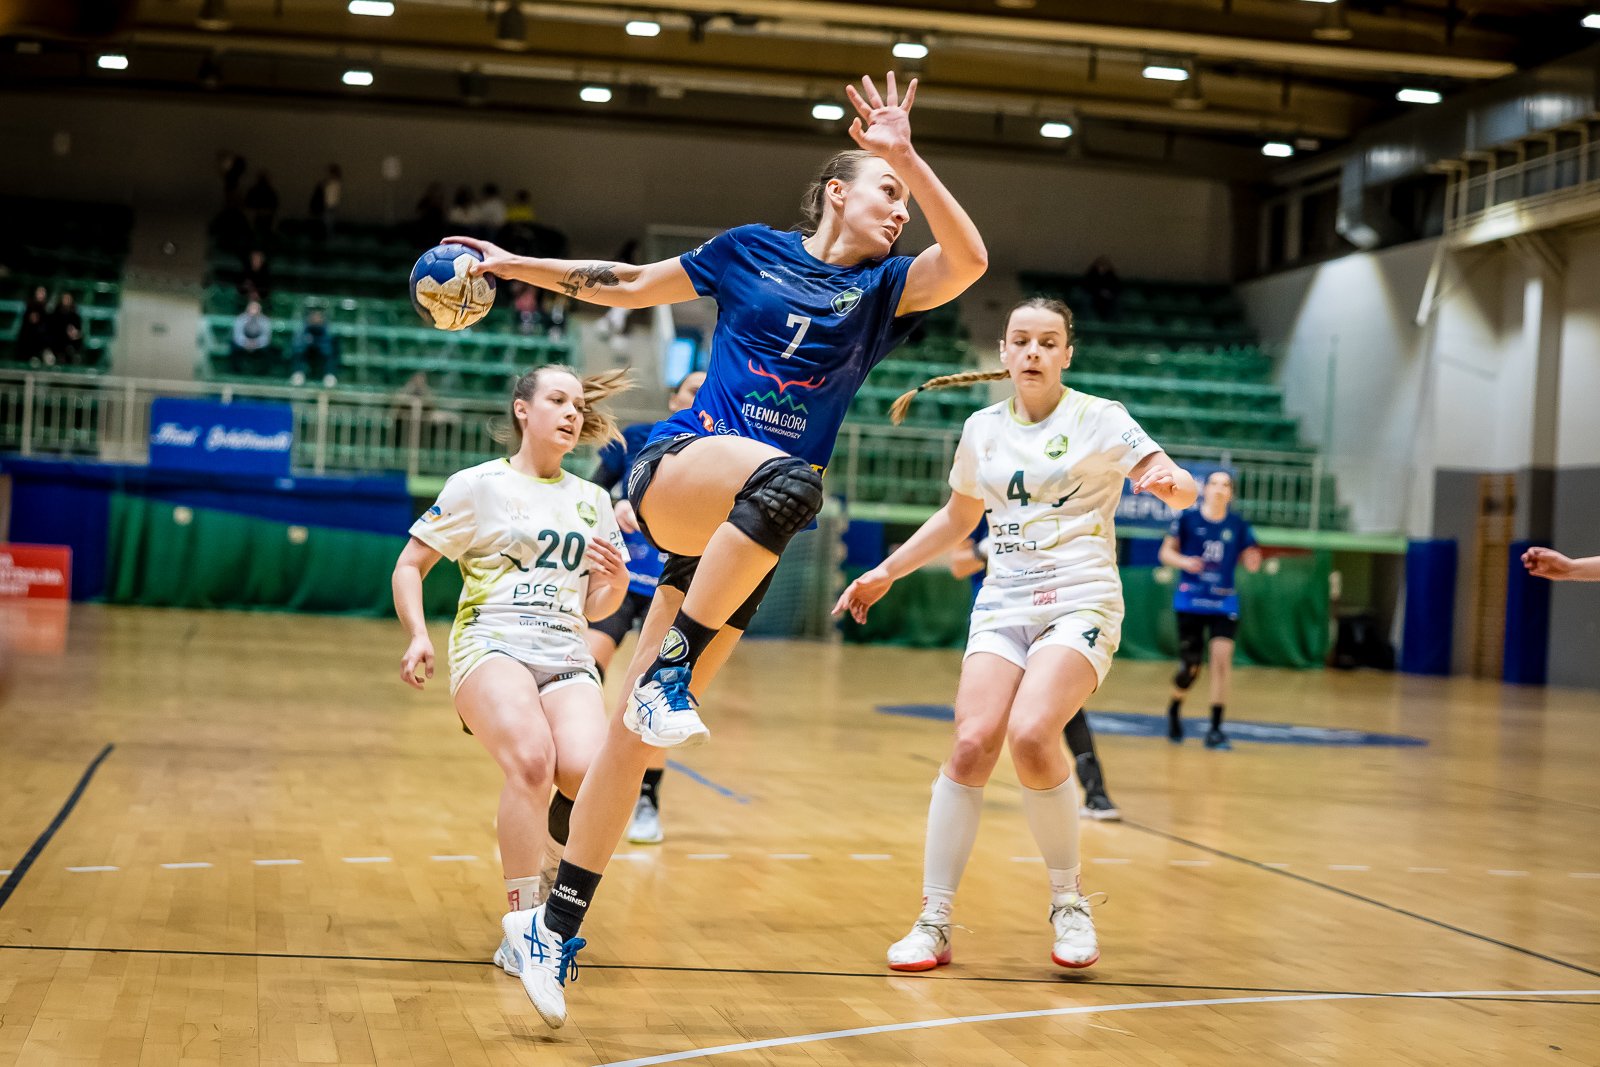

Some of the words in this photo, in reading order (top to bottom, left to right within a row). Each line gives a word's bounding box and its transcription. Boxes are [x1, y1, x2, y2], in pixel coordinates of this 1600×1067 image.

[780, 313, 812, 360] 7
[763, 425, 802, 440] KARKONOSZY
[780, 413, 807, 432] GÓRA
[1006, 470, 1032, 507] 4
[535, 528, 586, 572] 20
[513, 582, 558, 599] pre
[1081, 626, 1101, 649] 4
[558, 883, 579, 897] MKS
